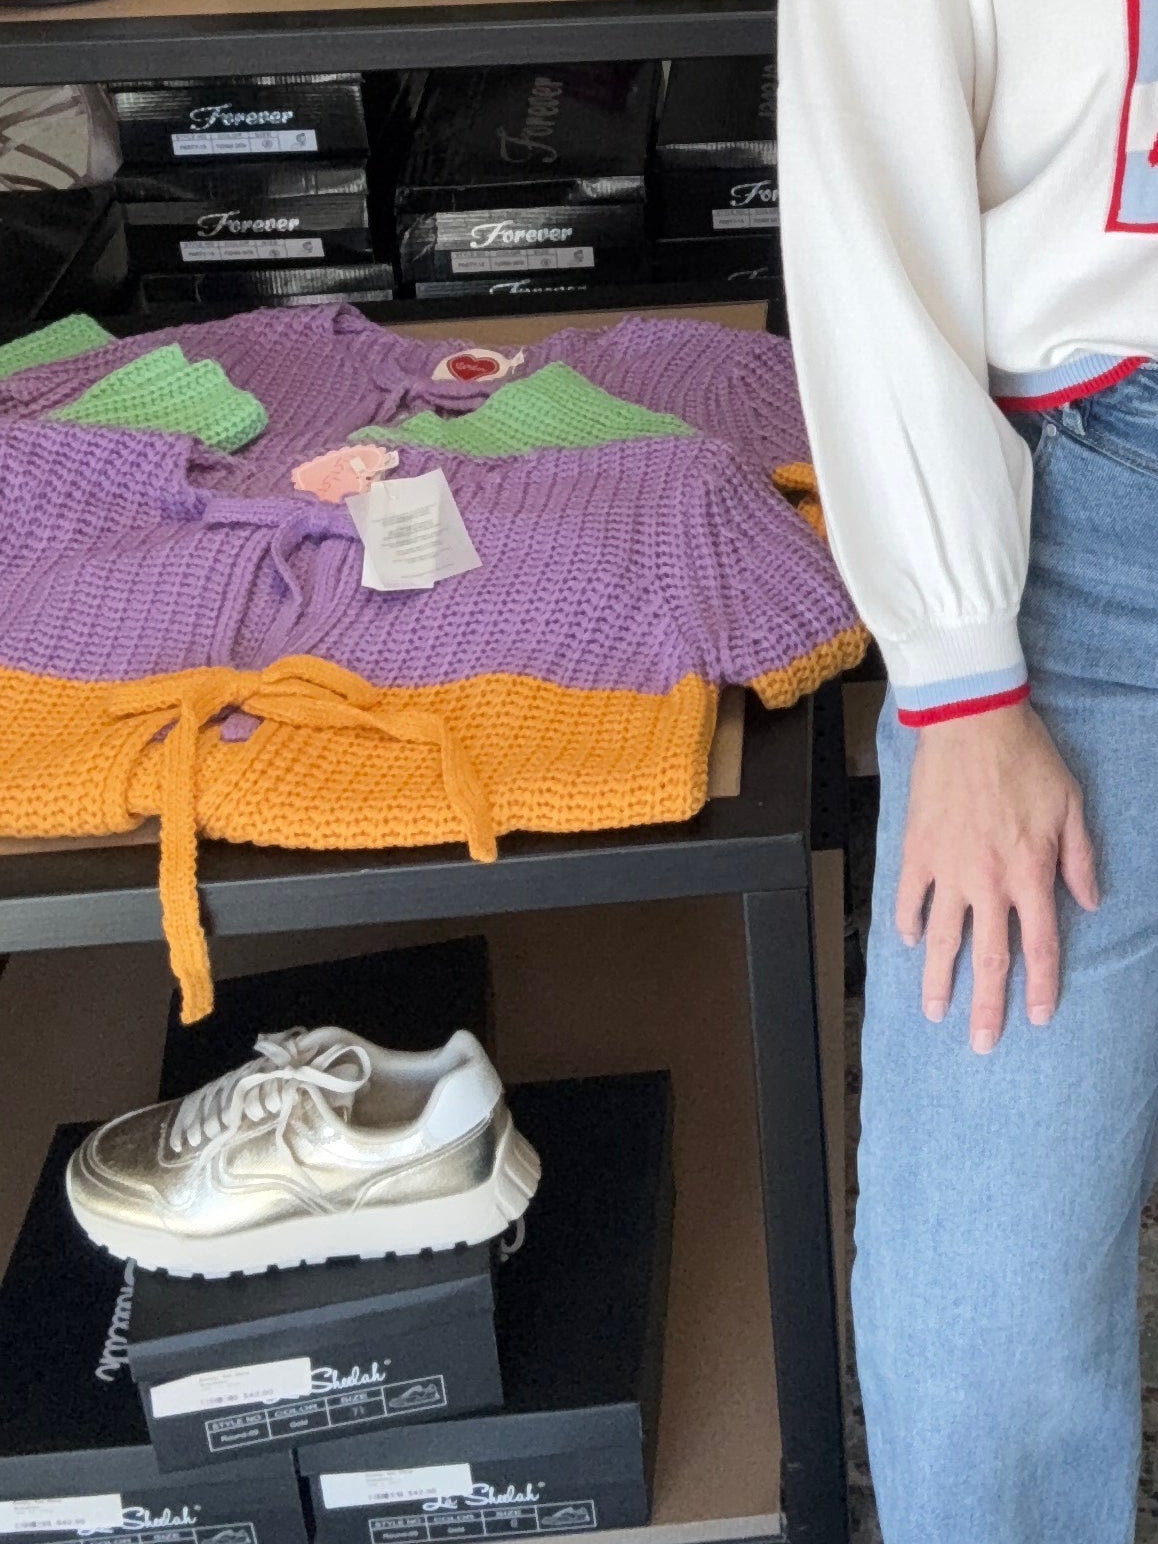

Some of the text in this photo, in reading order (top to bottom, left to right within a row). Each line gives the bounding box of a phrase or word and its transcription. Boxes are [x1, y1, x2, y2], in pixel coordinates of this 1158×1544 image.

[189, 103, 294, 131] Forever
[496, 77, 563, 164] Forever
[197, 210, 300, 237] Forever
[469, 220, 573, 249] Forever
